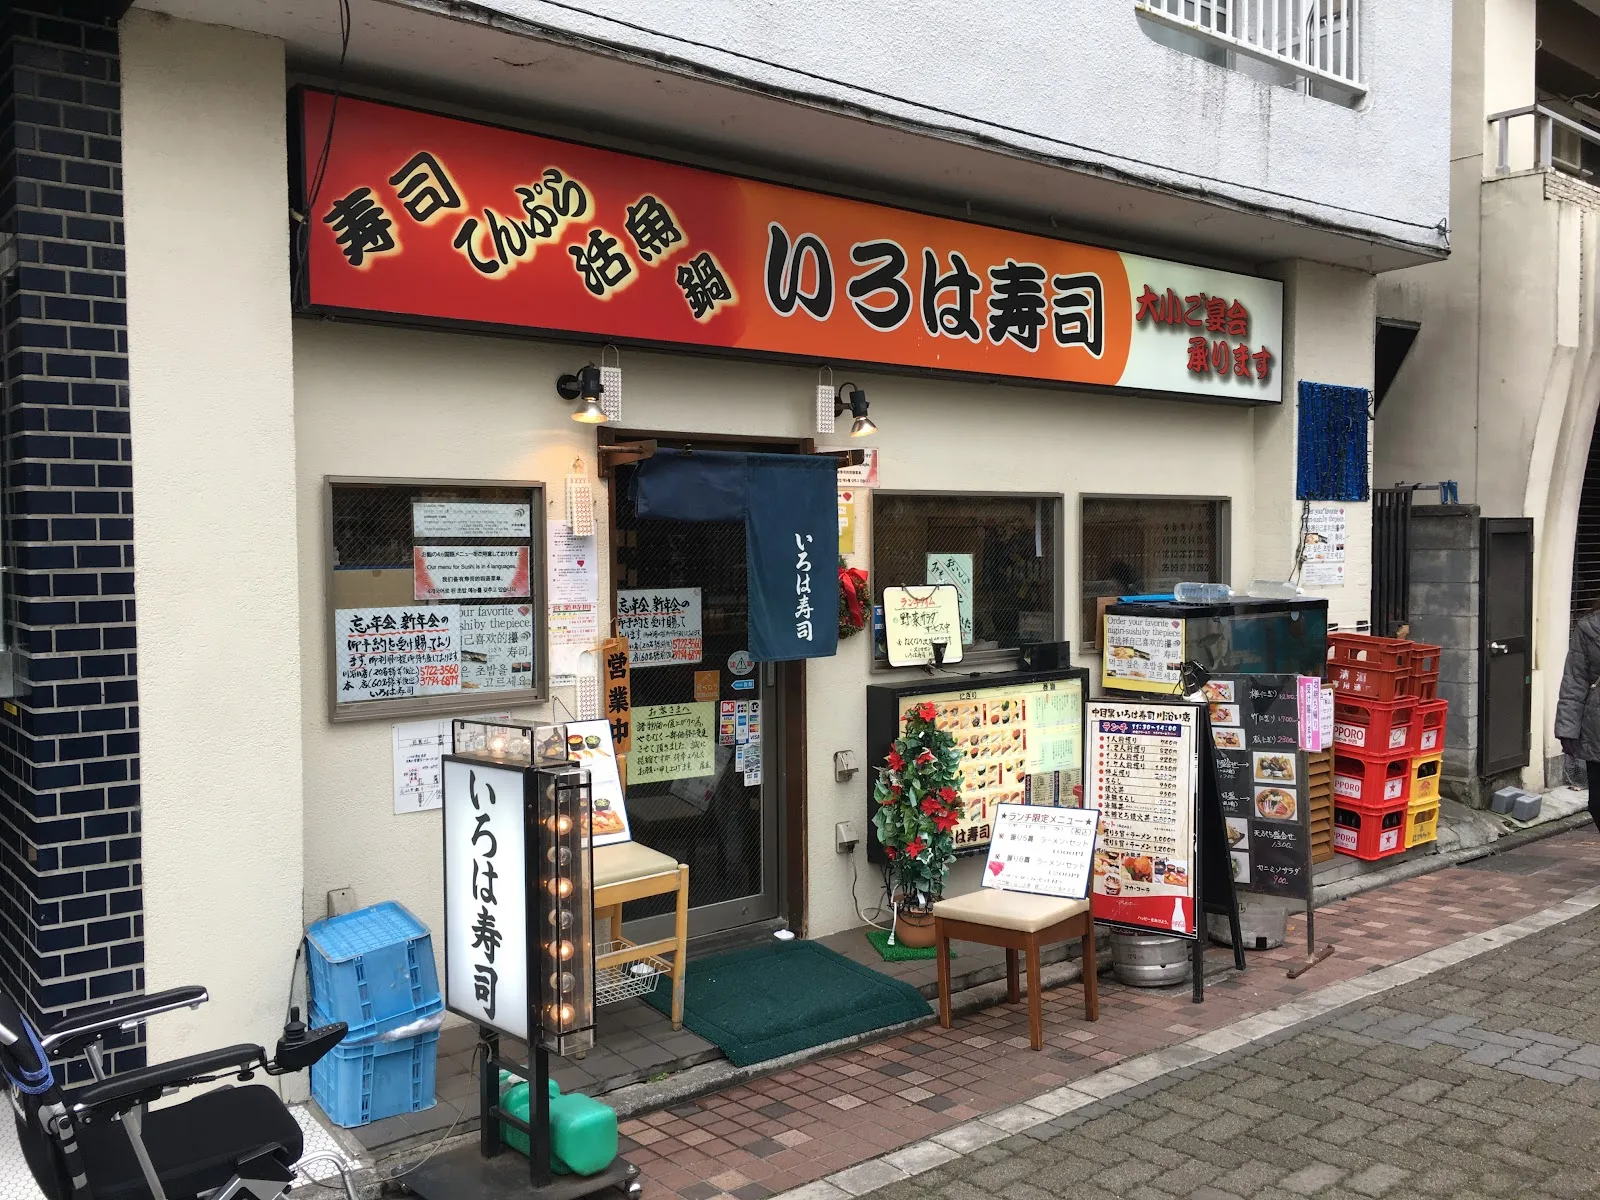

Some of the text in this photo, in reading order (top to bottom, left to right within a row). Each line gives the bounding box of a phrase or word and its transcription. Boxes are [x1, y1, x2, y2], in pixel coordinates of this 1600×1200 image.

[323, 151, 463, 266] 寿司
[453, 168, 589, 275] てんぷら
[568, 195, 683, 296] 活魚
[676, 252, 733, 319] 鍋
[764, 220, 1105, 360] いろは寿司
[1135, 283, 1248, 338] 大小ご宴会
[1186, 336, 1272, 380] 承ります
[794, 533, 815, 642] いろは寿司
[478, 605, 514, 617] favorite
[1107, 616, 1170, 628] Order your favorite
[475, 664, 508, 677] 초밥을
[369, 687, 414, 698] いろは寿司
[608, 651, 630, 745] 営業中
[722, 701, 734, 713] DC
[959, 691, 977, 700] にぎり
[648, 705, 691, 716] お客さまへ
[1102, 721, 1128, 734] ランチ
[1008, 812, 1084, 826] ランチ限定メニュー
[1256, 863, 1302, 876] カニミソサラダ
[469, 769, 503, 1021] いろは寿司
